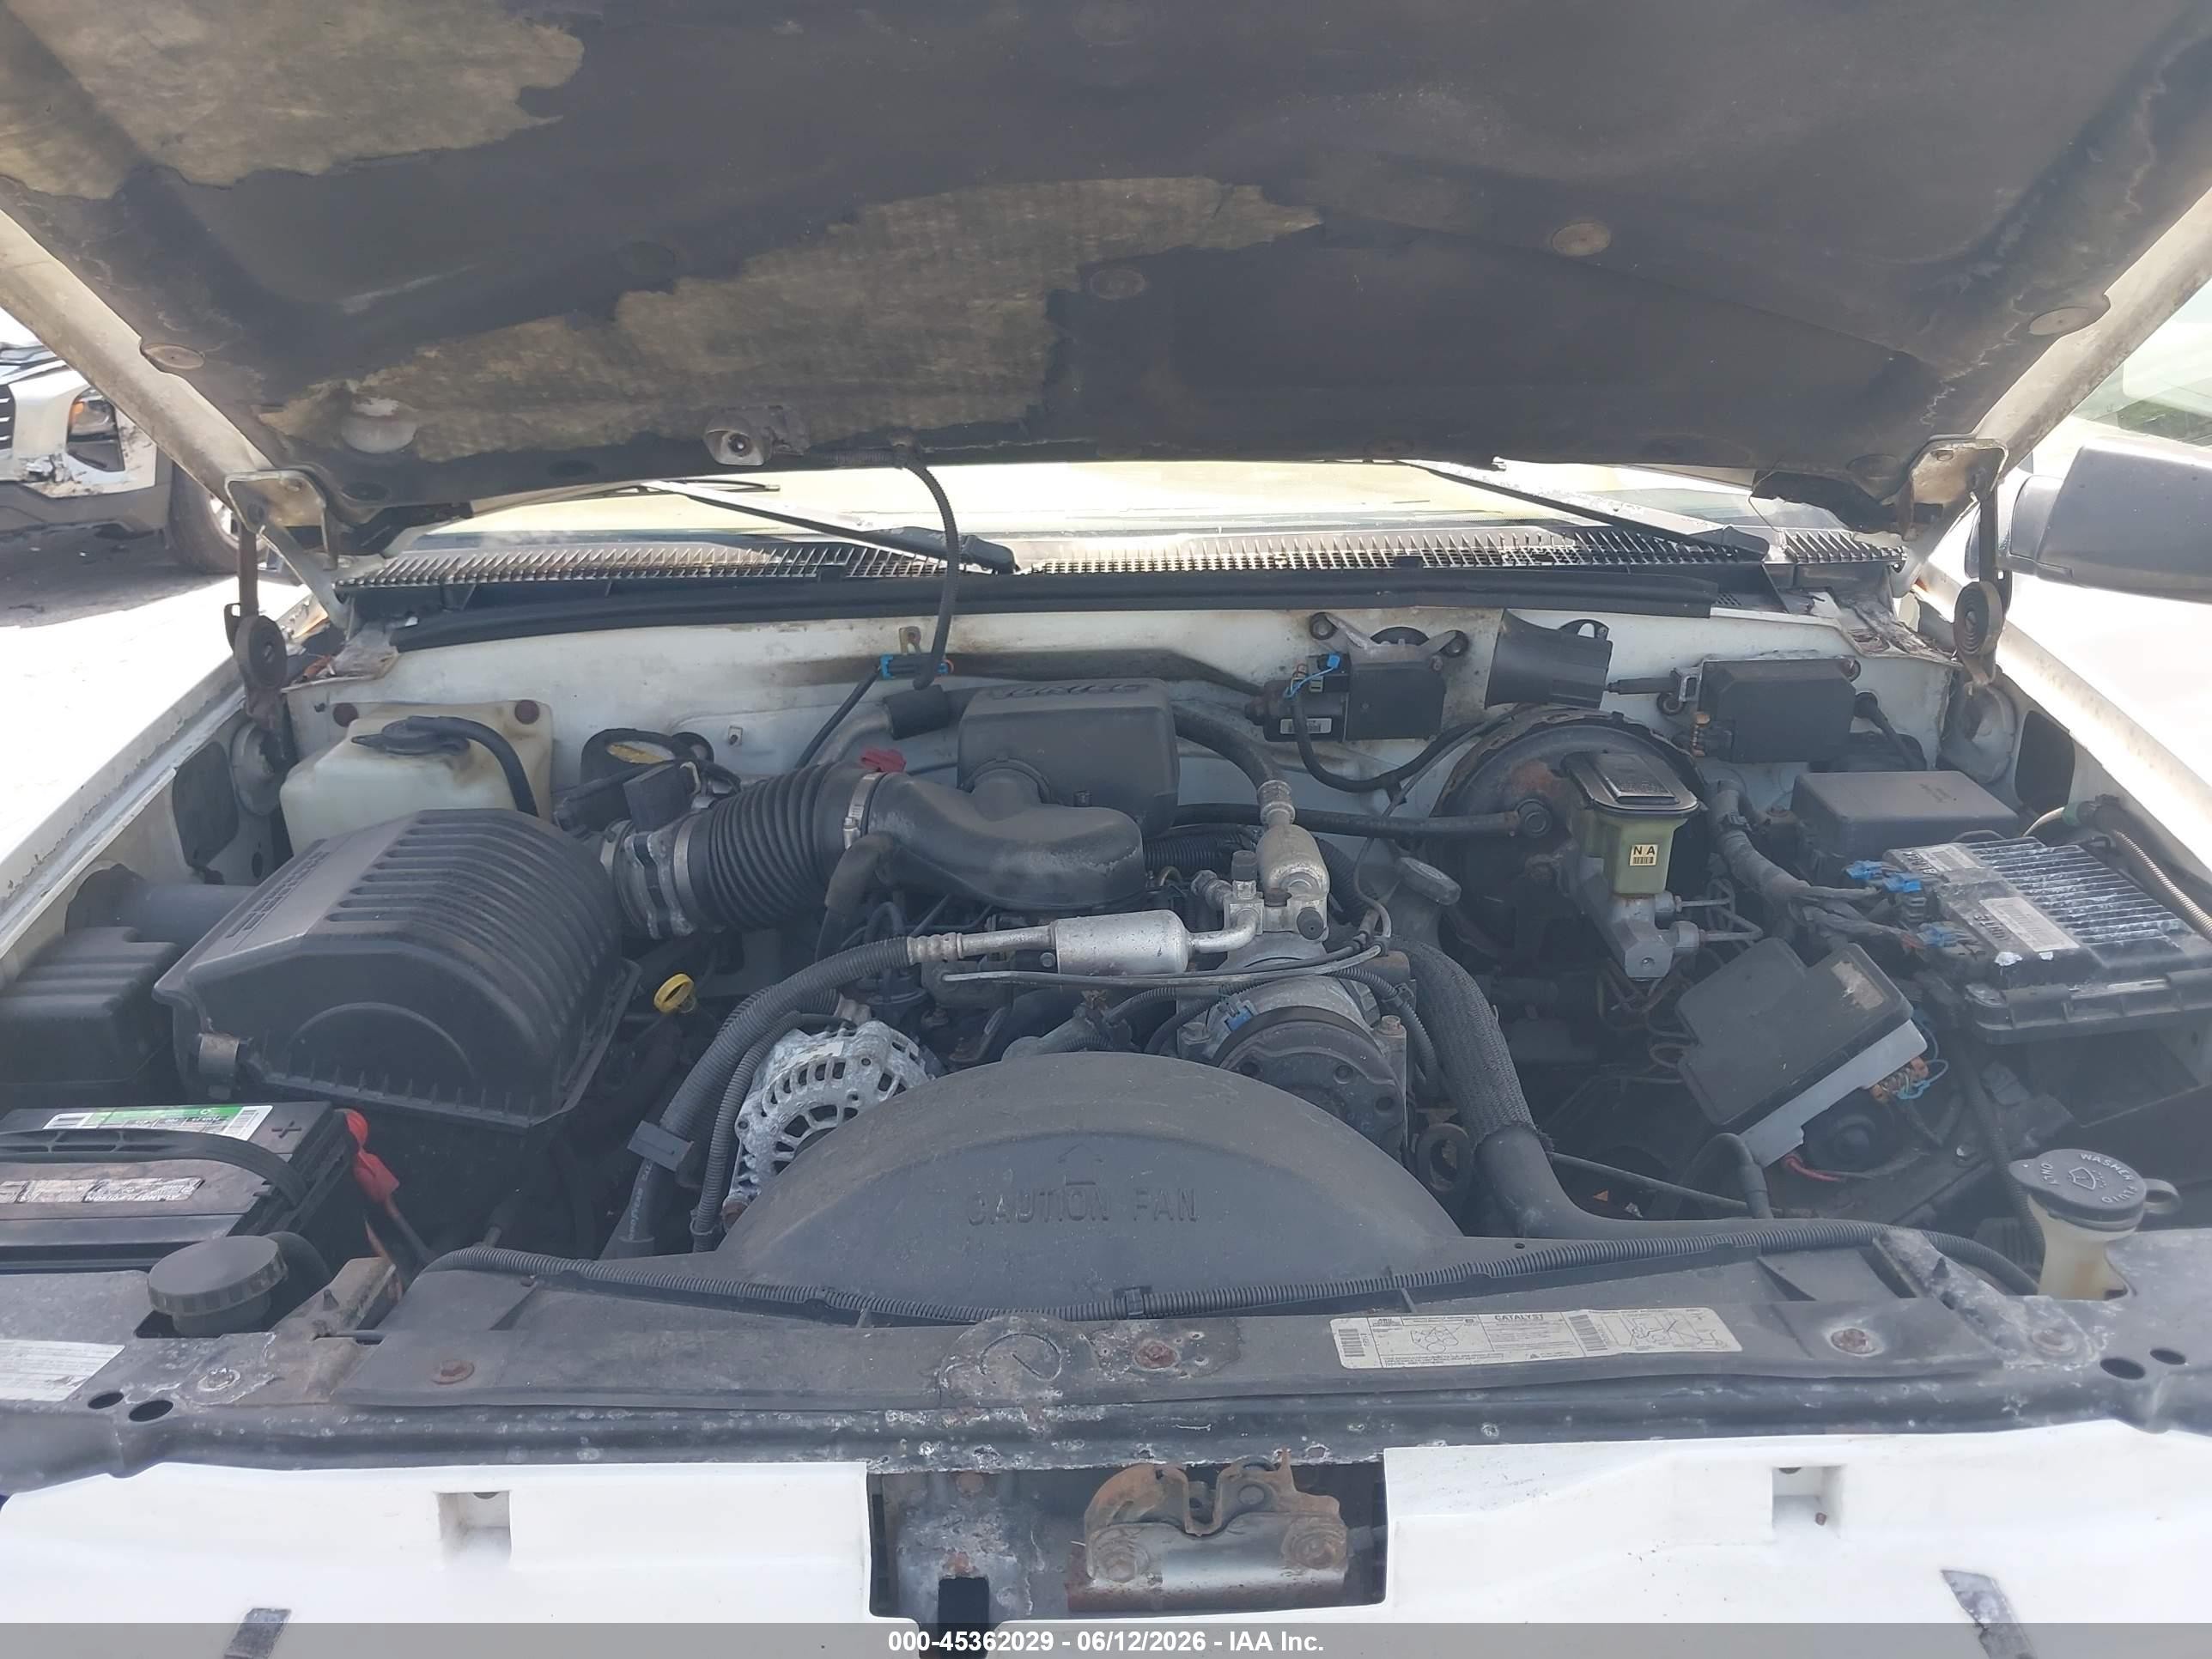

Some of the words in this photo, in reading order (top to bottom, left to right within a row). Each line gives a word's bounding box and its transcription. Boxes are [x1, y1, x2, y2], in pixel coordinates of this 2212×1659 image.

[2040, 1162, 2061, 1185] ONLY
[2081, 1153, 2134, 1181] WASHER
[968, 1188, 1110, 1225] CAUTION
[1133, 1188, 1197, 1222] FAN
[2101, 1185, 2137, 1203] FLUID
